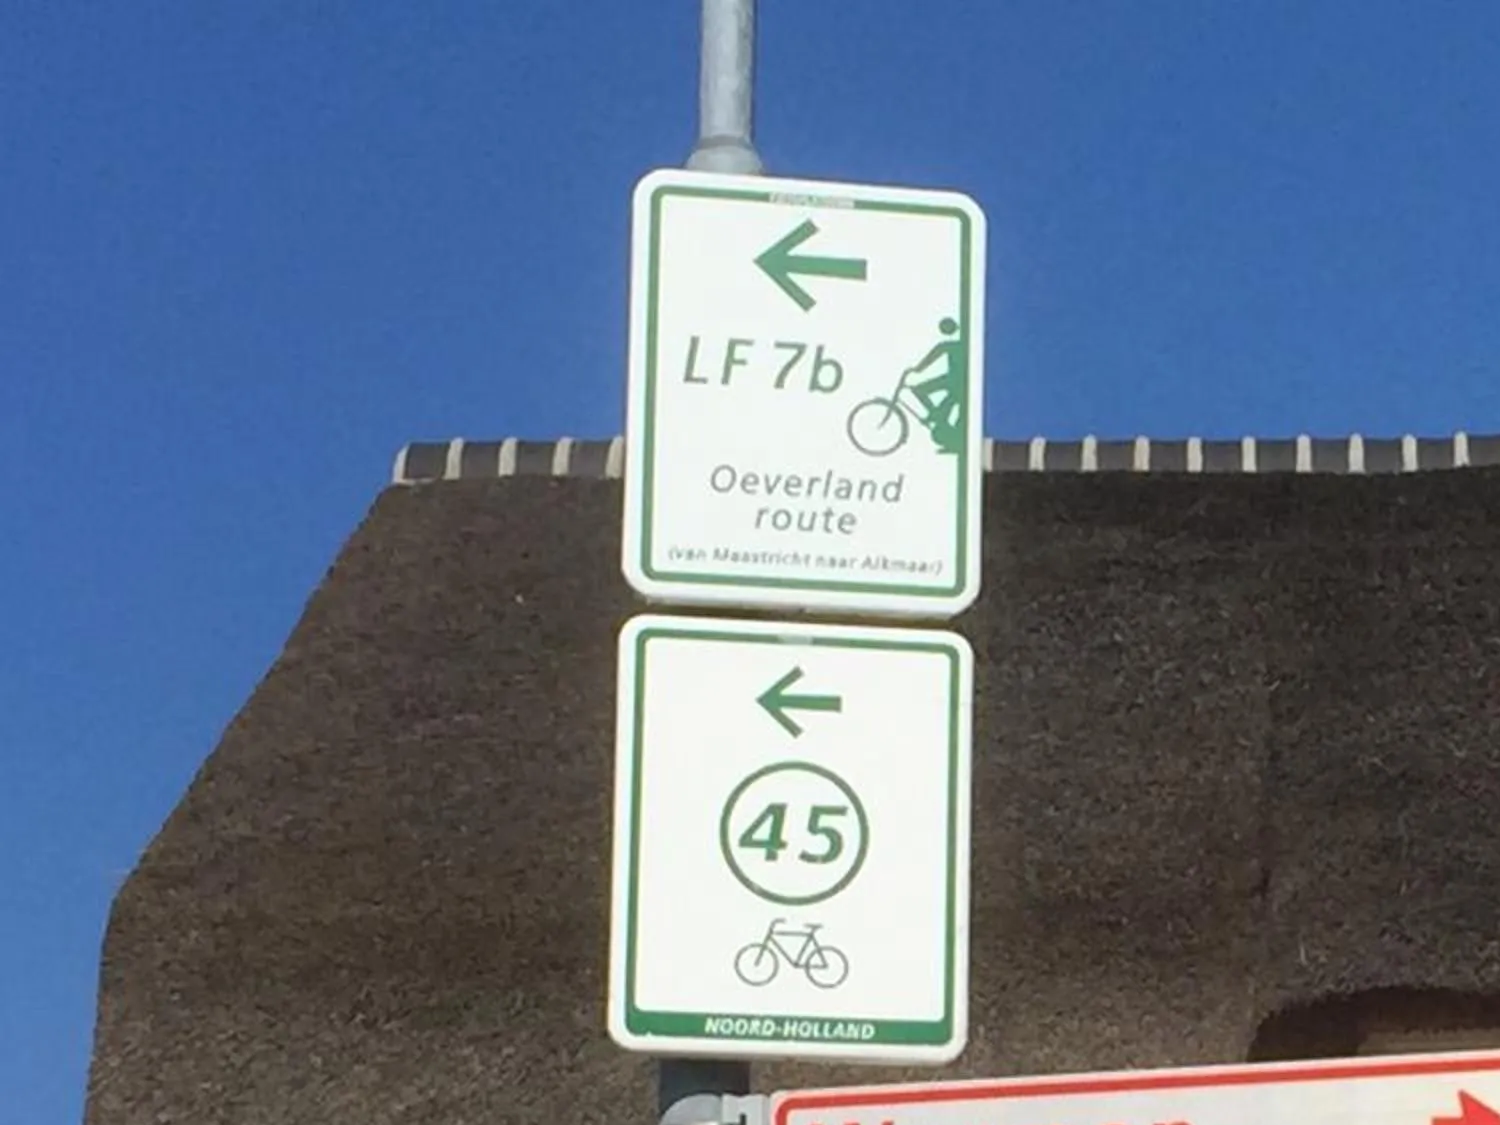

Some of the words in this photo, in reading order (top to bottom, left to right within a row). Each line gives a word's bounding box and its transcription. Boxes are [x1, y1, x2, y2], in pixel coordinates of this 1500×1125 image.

[682, 335, 754, 386] LF
[772, 341, 844, 394] 7b
[709, 463, 905, 503] Oeverland
[753, 505, 857, 535] route
[667, 545, 707, 564] (van
[712, 547, 811, 569] Maastricht
[815, 553, 856, 571] naar
[861, 553, 943, 577] Alkmaar)
[738, 802, 849, 864] 45
[704, 1016, 876, 1041] NOORD-HOLLAND
